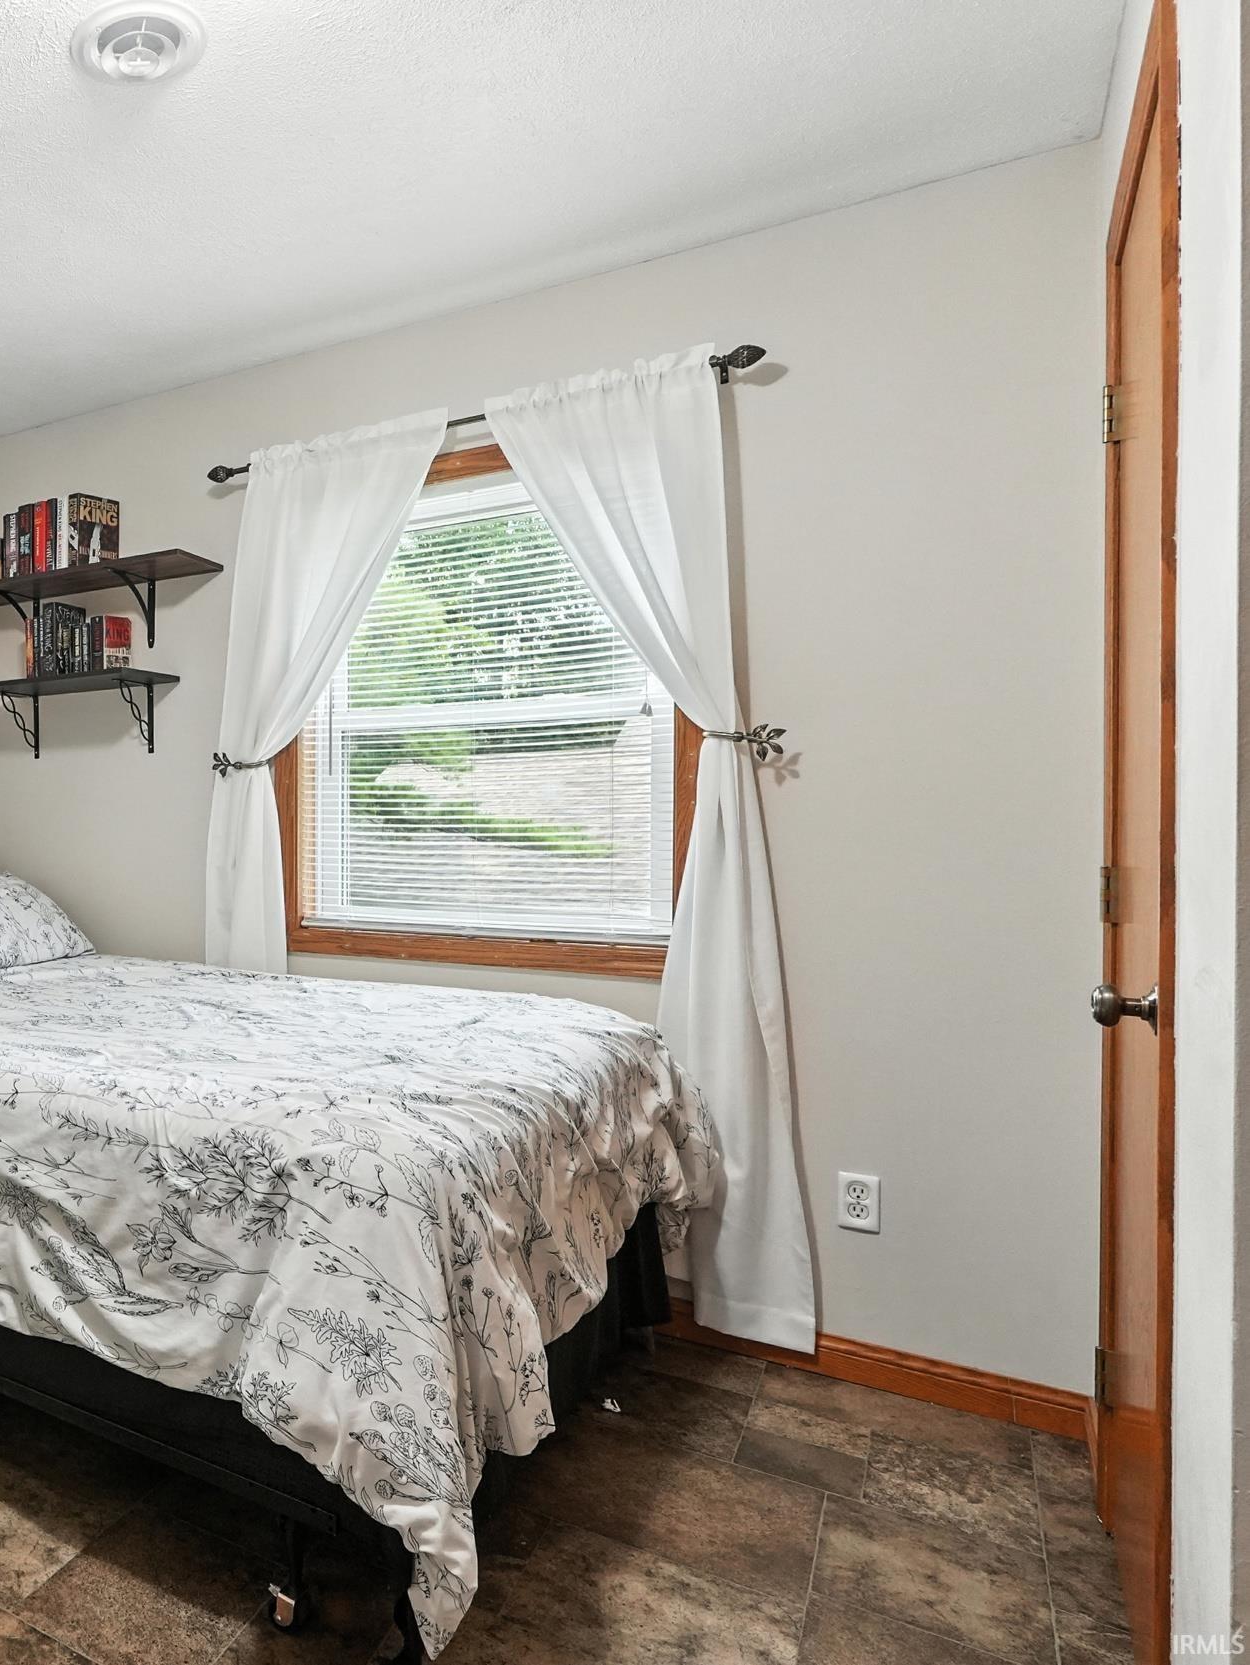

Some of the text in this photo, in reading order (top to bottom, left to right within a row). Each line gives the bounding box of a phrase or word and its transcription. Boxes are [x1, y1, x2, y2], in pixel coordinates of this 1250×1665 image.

[80, 497, 118, 512] STEPHEN
[80, 506, 118, 526] KING
[106, 627, 130, 641] KING
